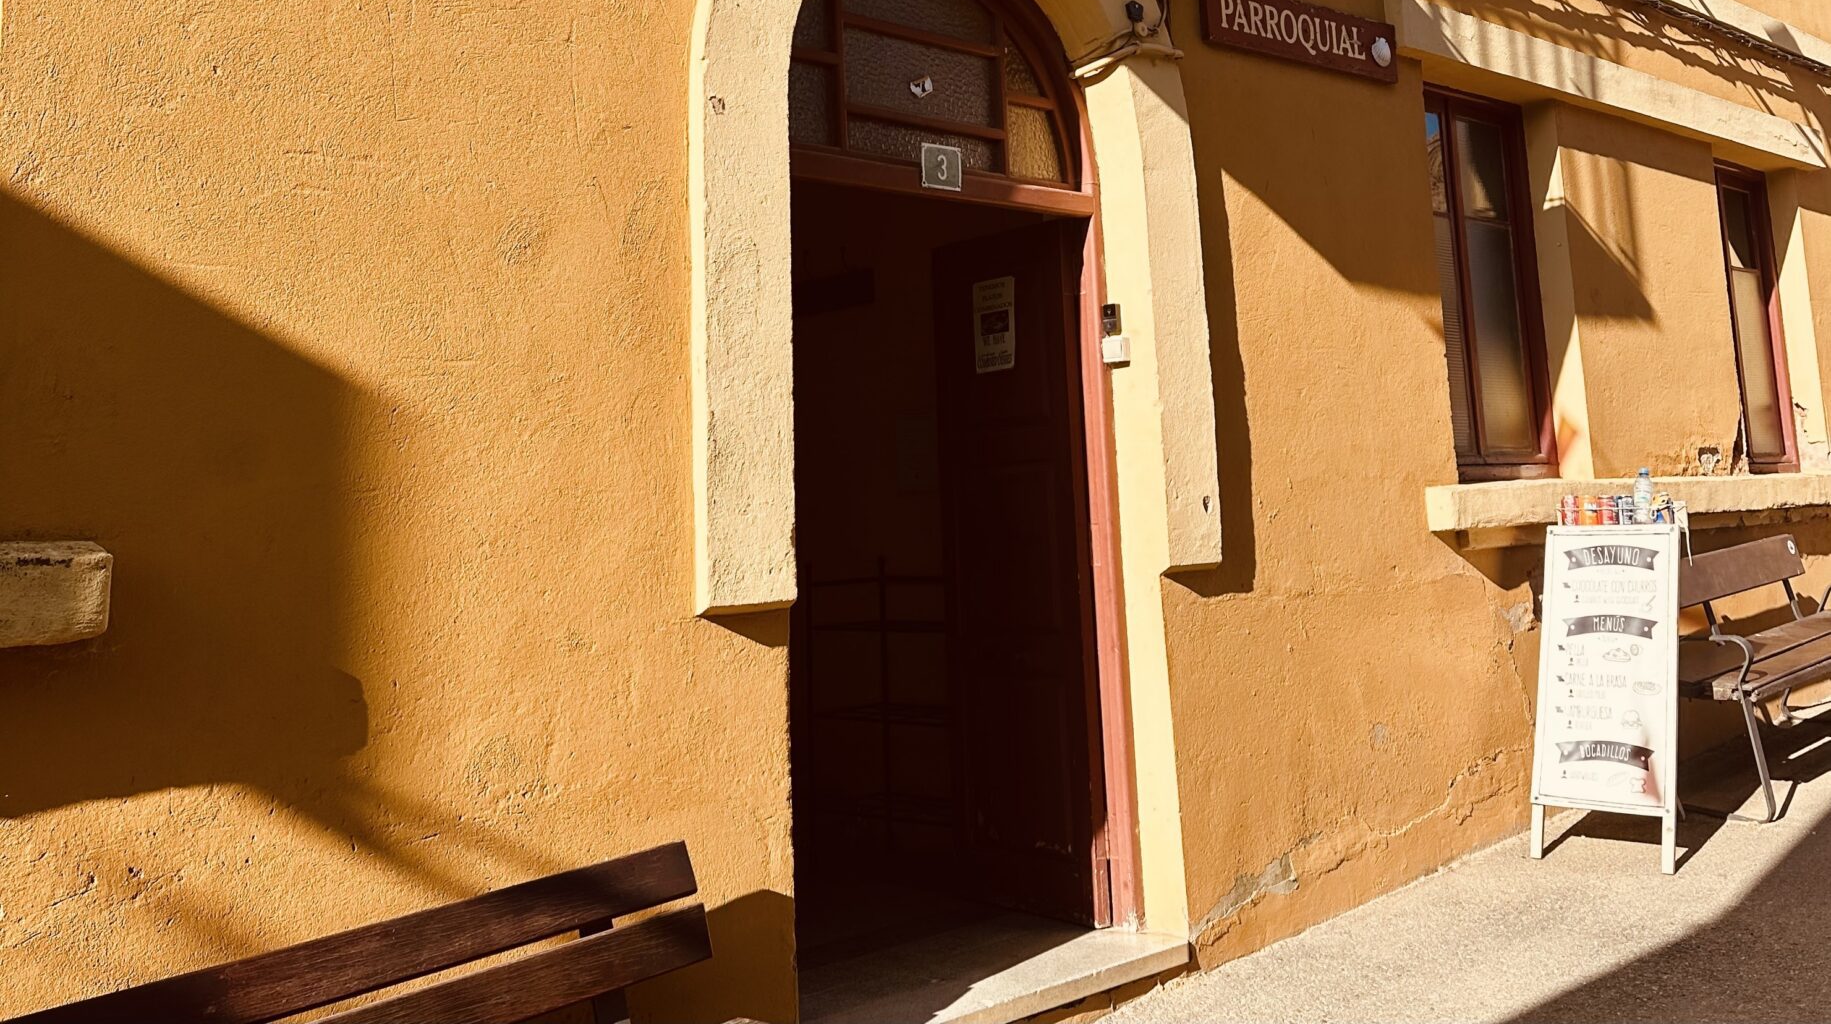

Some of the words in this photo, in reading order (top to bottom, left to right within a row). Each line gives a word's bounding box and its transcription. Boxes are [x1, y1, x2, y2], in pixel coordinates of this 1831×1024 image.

[936, 154, 948, 181] 3
[1582, 546, 1640, 566] DESAYUNO
[1579, 743, 1631, 762] BOCADILLOS
